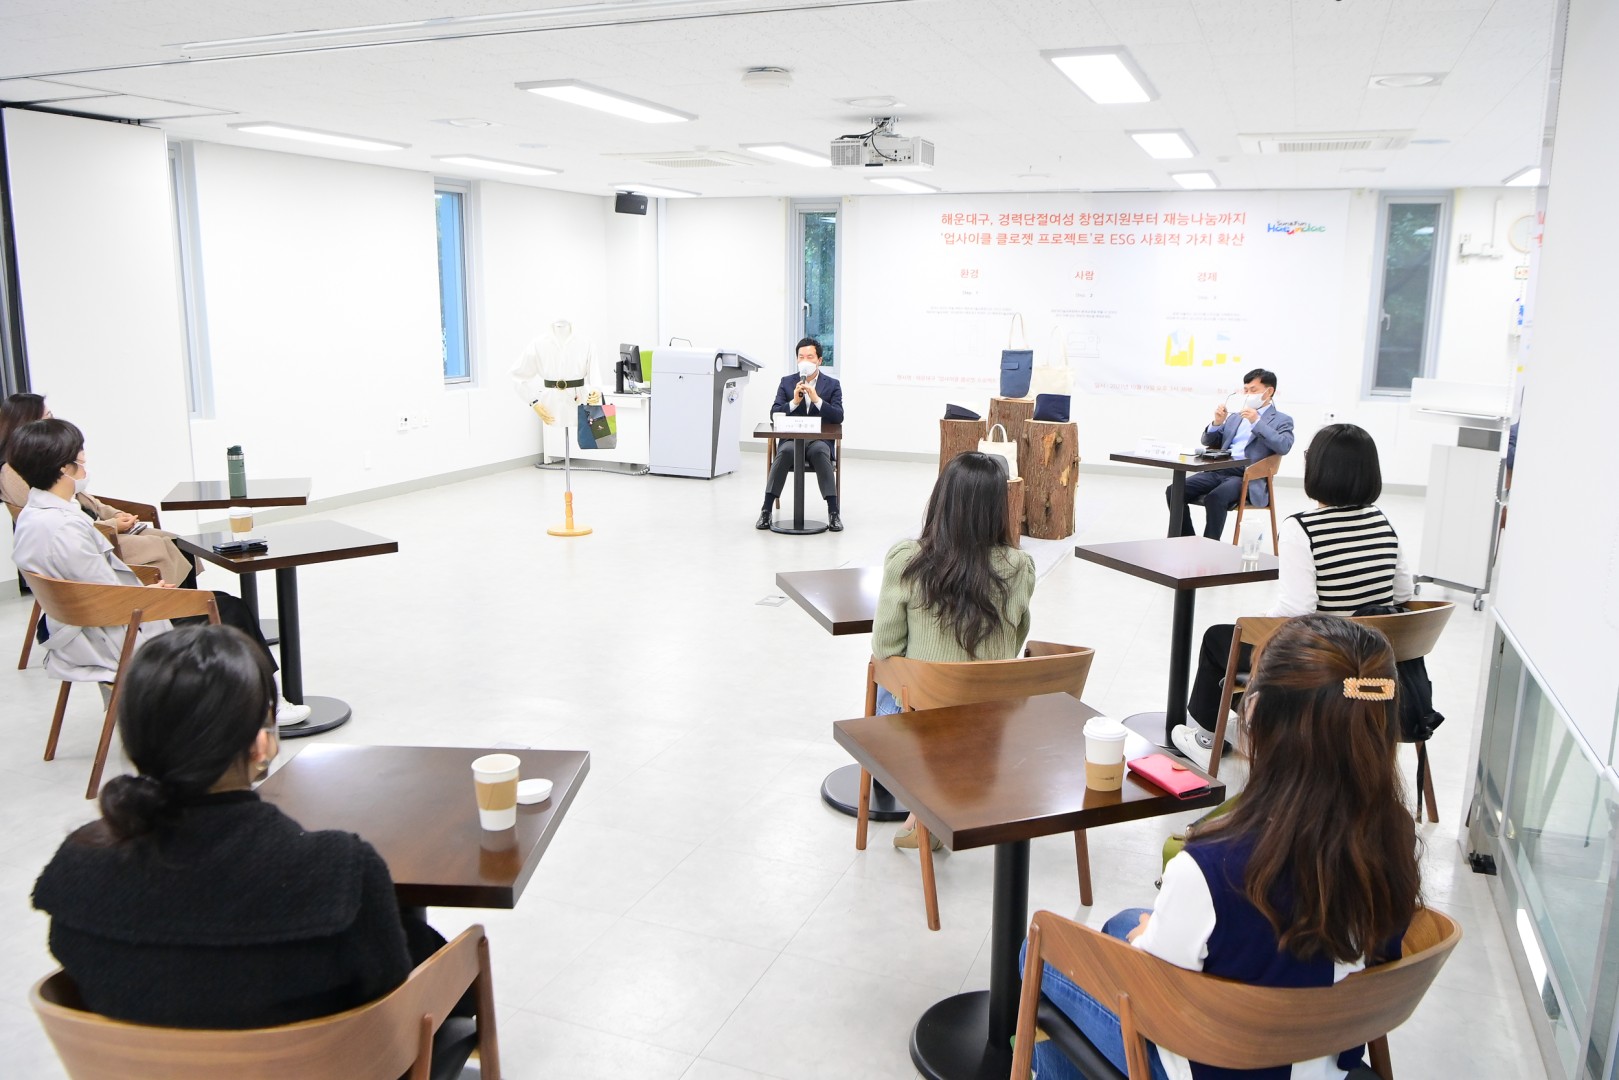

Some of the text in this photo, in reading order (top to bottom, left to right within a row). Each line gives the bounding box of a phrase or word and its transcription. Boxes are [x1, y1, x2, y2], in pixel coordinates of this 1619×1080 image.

[941, 211, 1247, 227] 해운대구, 경력단절여성 창업지원부터 재능나눔까지
[995, 232, 1034, 246] 클로젯
[1109, 232, 1136, 246] ESG
[1140, 232, 1181, 246] 사회적
[1185, 232, 1213, 246] 가치
[1217, 232, 1246, 246] 확산
[960, 268, 979, 279] 환경
[1074, 269, 1095, 282] 사람
[1196, 271, 1218, 282] 경제
